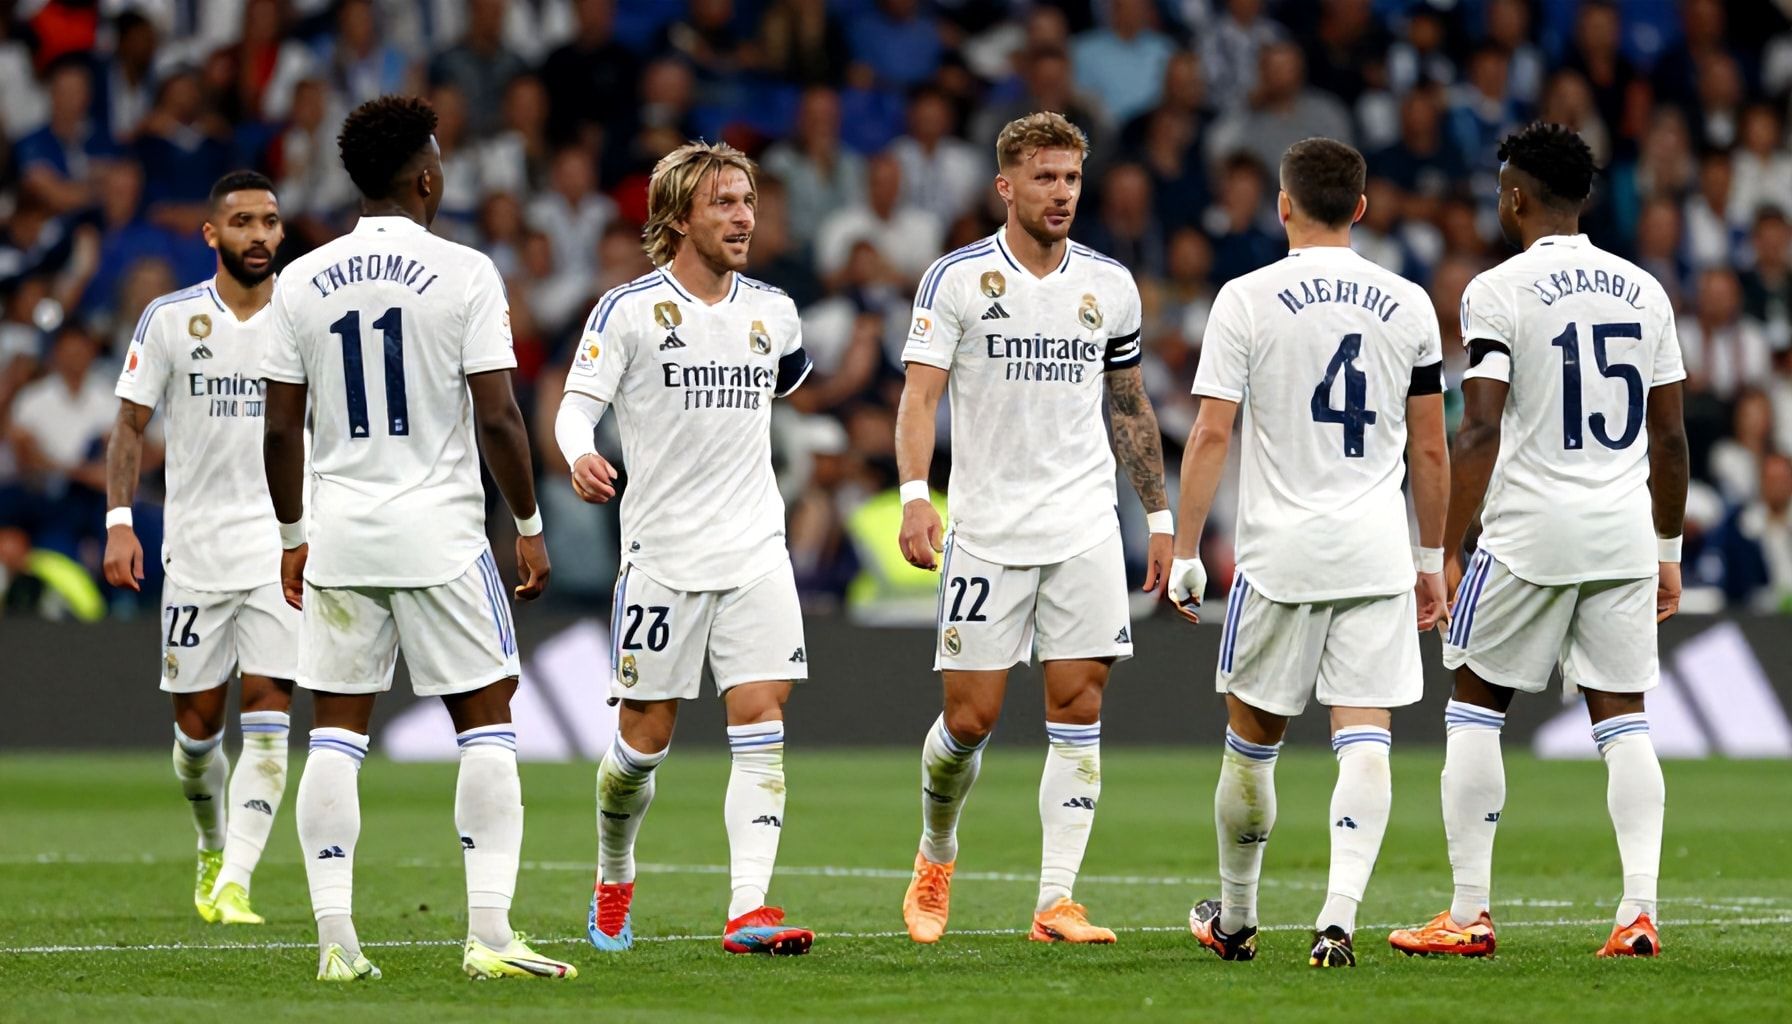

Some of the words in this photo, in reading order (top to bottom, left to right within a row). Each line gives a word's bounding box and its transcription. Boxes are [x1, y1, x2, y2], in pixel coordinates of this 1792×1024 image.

[330, 307, 409, 439] 11
[1311, 333, 1377, 458] 4
[1552, 321, 1644, 450] 15
[622, 604, 670, 652] 23
[949, 576, 990, 622] 22
